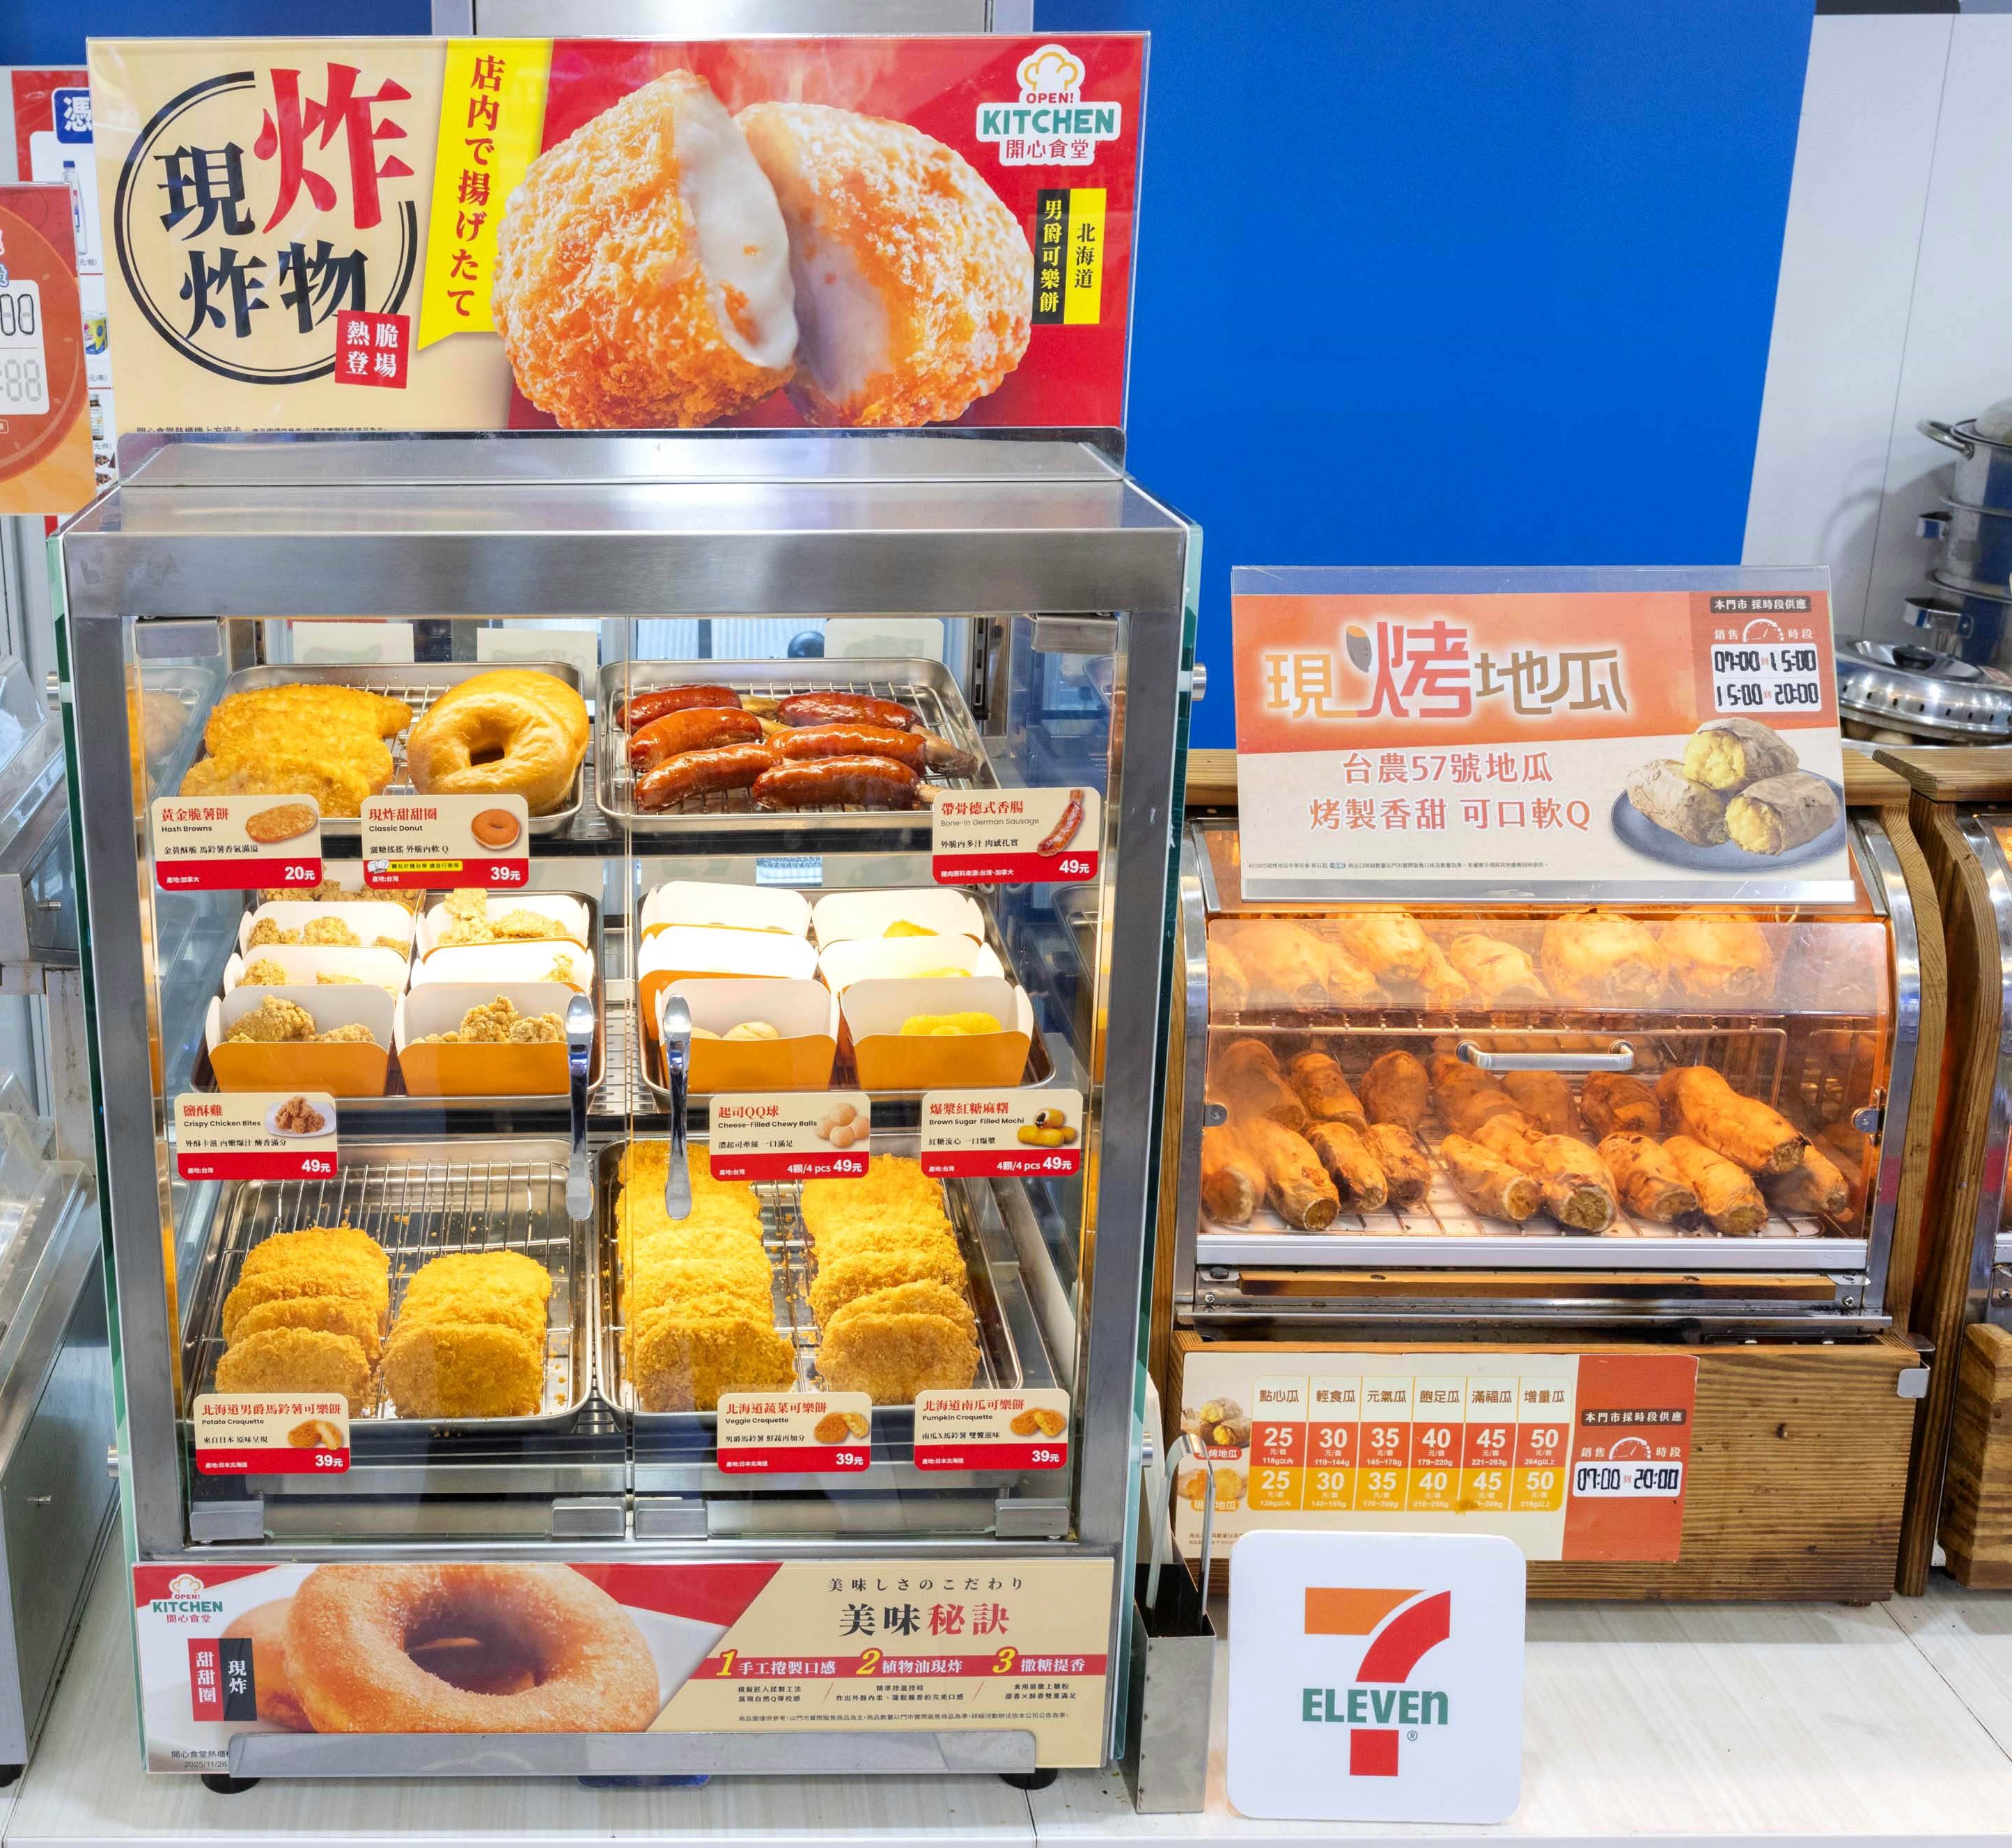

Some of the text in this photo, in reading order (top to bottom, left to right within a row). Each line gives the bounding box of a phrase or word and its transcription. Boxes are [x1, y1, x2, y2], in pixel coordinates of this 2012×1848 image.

[1027, 93, 1073, 104] OPEN!
[982, 108, 1116, 134] KITCHEN
[1006, 139, 1089, 159] 開心食堂
[446, 54, 506, 320] 店内で揚げたて
[1040, 199, 1063, 313] 男爵可樂餅
[1075, 223, 1095, 290] 北海道
[179, 240, 369, 341] 炸物
[1715, 599, 1807, 610] 本門市 採時段供應
[1714, 629, 1813, 640] 銷售 時段
[1715, 650, 1817, 673] 07:00 到 15:00
[1265, 620, 1628, 719] 現烤地瓜
[1717, 682, 1819, 706] 15:00 到 20:00
[1344, 751, 1554, 785] 台農57號地瓜
[162, 807, 229, 822] 黃金脆薯餅
[368, 807, 437, 821] 現炸甜甜圈
[942, 800, 1024, 816] 帶骨德式香腸
[1310, 797, 1591, 832] 烤製香甜 可口軟Q
[1006, 817, 1039, 826] Sausage
[164, 845, 258, 854] 金黃酥脆 馬鈴薯香氣滿溢
[407, 845, 439, 853] 外脆內軟
[442, 845, 449, 854] Q
[942, 838, 1018, 848] 外脆內多汁 肉感扎實
[285, 866, 315, 880] 20元
[490, 867, 521, 881] 39元
[1059, 860, 1090, 874] 49元
[183, 1104, 223, 1117] 鹽酥雞
[719, 1105, 779, 1118] 起司QQ球
[930, 1102, 1009, 1114] 爆漿紅糖麻糬
[185, 1139, 217, 1148] 外酥卡滋
[719, 1141, 758, 1149] 濃起司牽絲
[302, 1159, 331, 1173] 49元
[815, 1166, 831, 1174] pcs
[833, 1159, 862, 1173] 49元
[1024, 1162, 1040, 1170] pcs
[1043, 1157, 1072, 1170] 49元
[1260, 1390, 1565, 1404] 點心瓜 輕食瓜 元氣瓜 飽足瓜 滿福瓜 增量瓜
[202, 1403, 341, 1416] 北海道男爵馬鈴薯可樂餅
[726, 1402, 827, 1414] 北海道蔬菜可樂餅
[923, 1399, 1024, 1411] 北海道南瓜可樂餅
[1585, 1412, 1683, 1423] 本門市採時段供應
[1263, 1427, 1559, 1448] 25 30 35 40 45 50
[1031, 1450, 1059, 1462] 39元
[1580, 1447, 1681, 1457] 銷售 時段
[315, 1455, 343, 1467] 39元
[836, 1453, 864, 1466] 39元
[1261, 1471, 1554, 1491] 25 30 35 40 45 50
[1577, 1468, 1679, 1491] 07:00 到 20:00
[827, 1578, 1023, 1592] 美味しさのこだわり
[153, 1602, 223, 1613] KITCHEN
[166, 1614, 211, 1624] 開心食堂
[839, 1603, 1009, 1637] 美味秘訣
[716, 1650, 836, 1676] 1 手工捲製口感
[856, 1650, 963, 1675] 2 植物油現炸
[992, 1648, 1085, 1673] 3 撒糖提香
[196, 1652, 217, 1703] 甜甜圈
[228, 1660, 247, 1694] 現炸
[1304, 1588, 1451, 1777] 7
